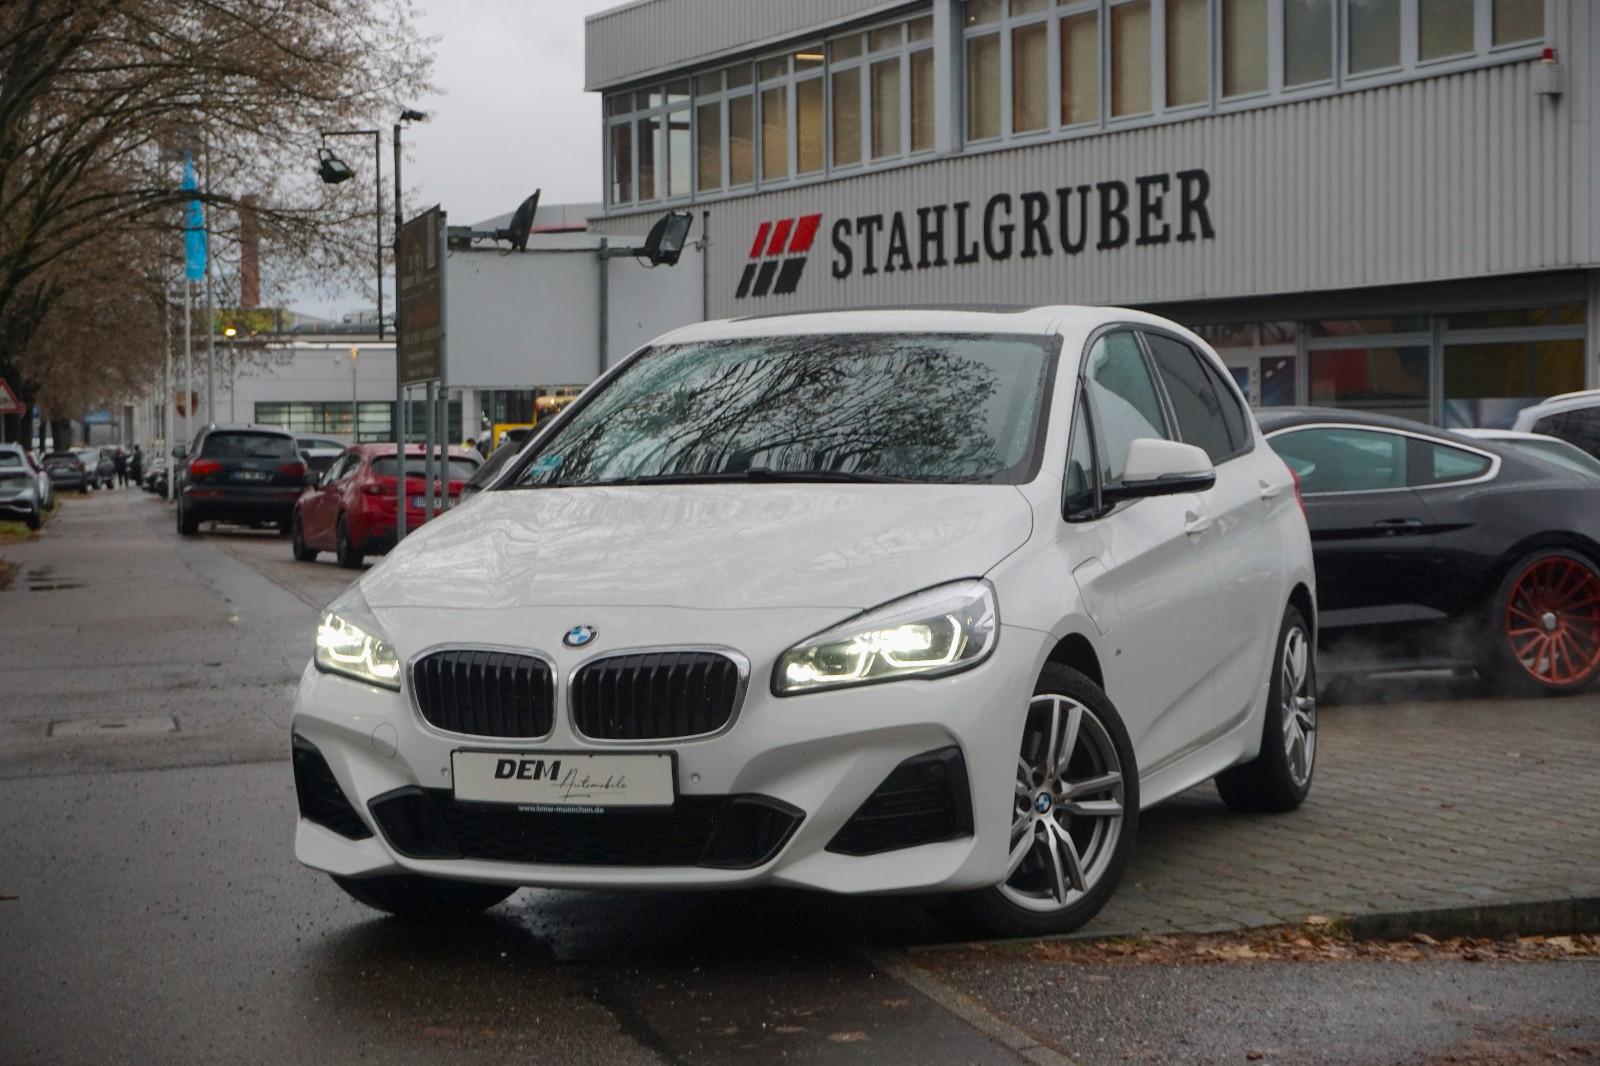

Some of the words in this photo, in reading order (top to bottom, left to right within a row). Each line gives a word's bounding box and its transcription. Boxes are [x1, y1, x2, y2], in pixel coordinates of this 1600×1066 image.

[831, 168, 1215, 280] STAHLGRUBER
[494, 758, 562, 781] DEM
[518, 804, 605, 814] www.bmw-muenchen.de
